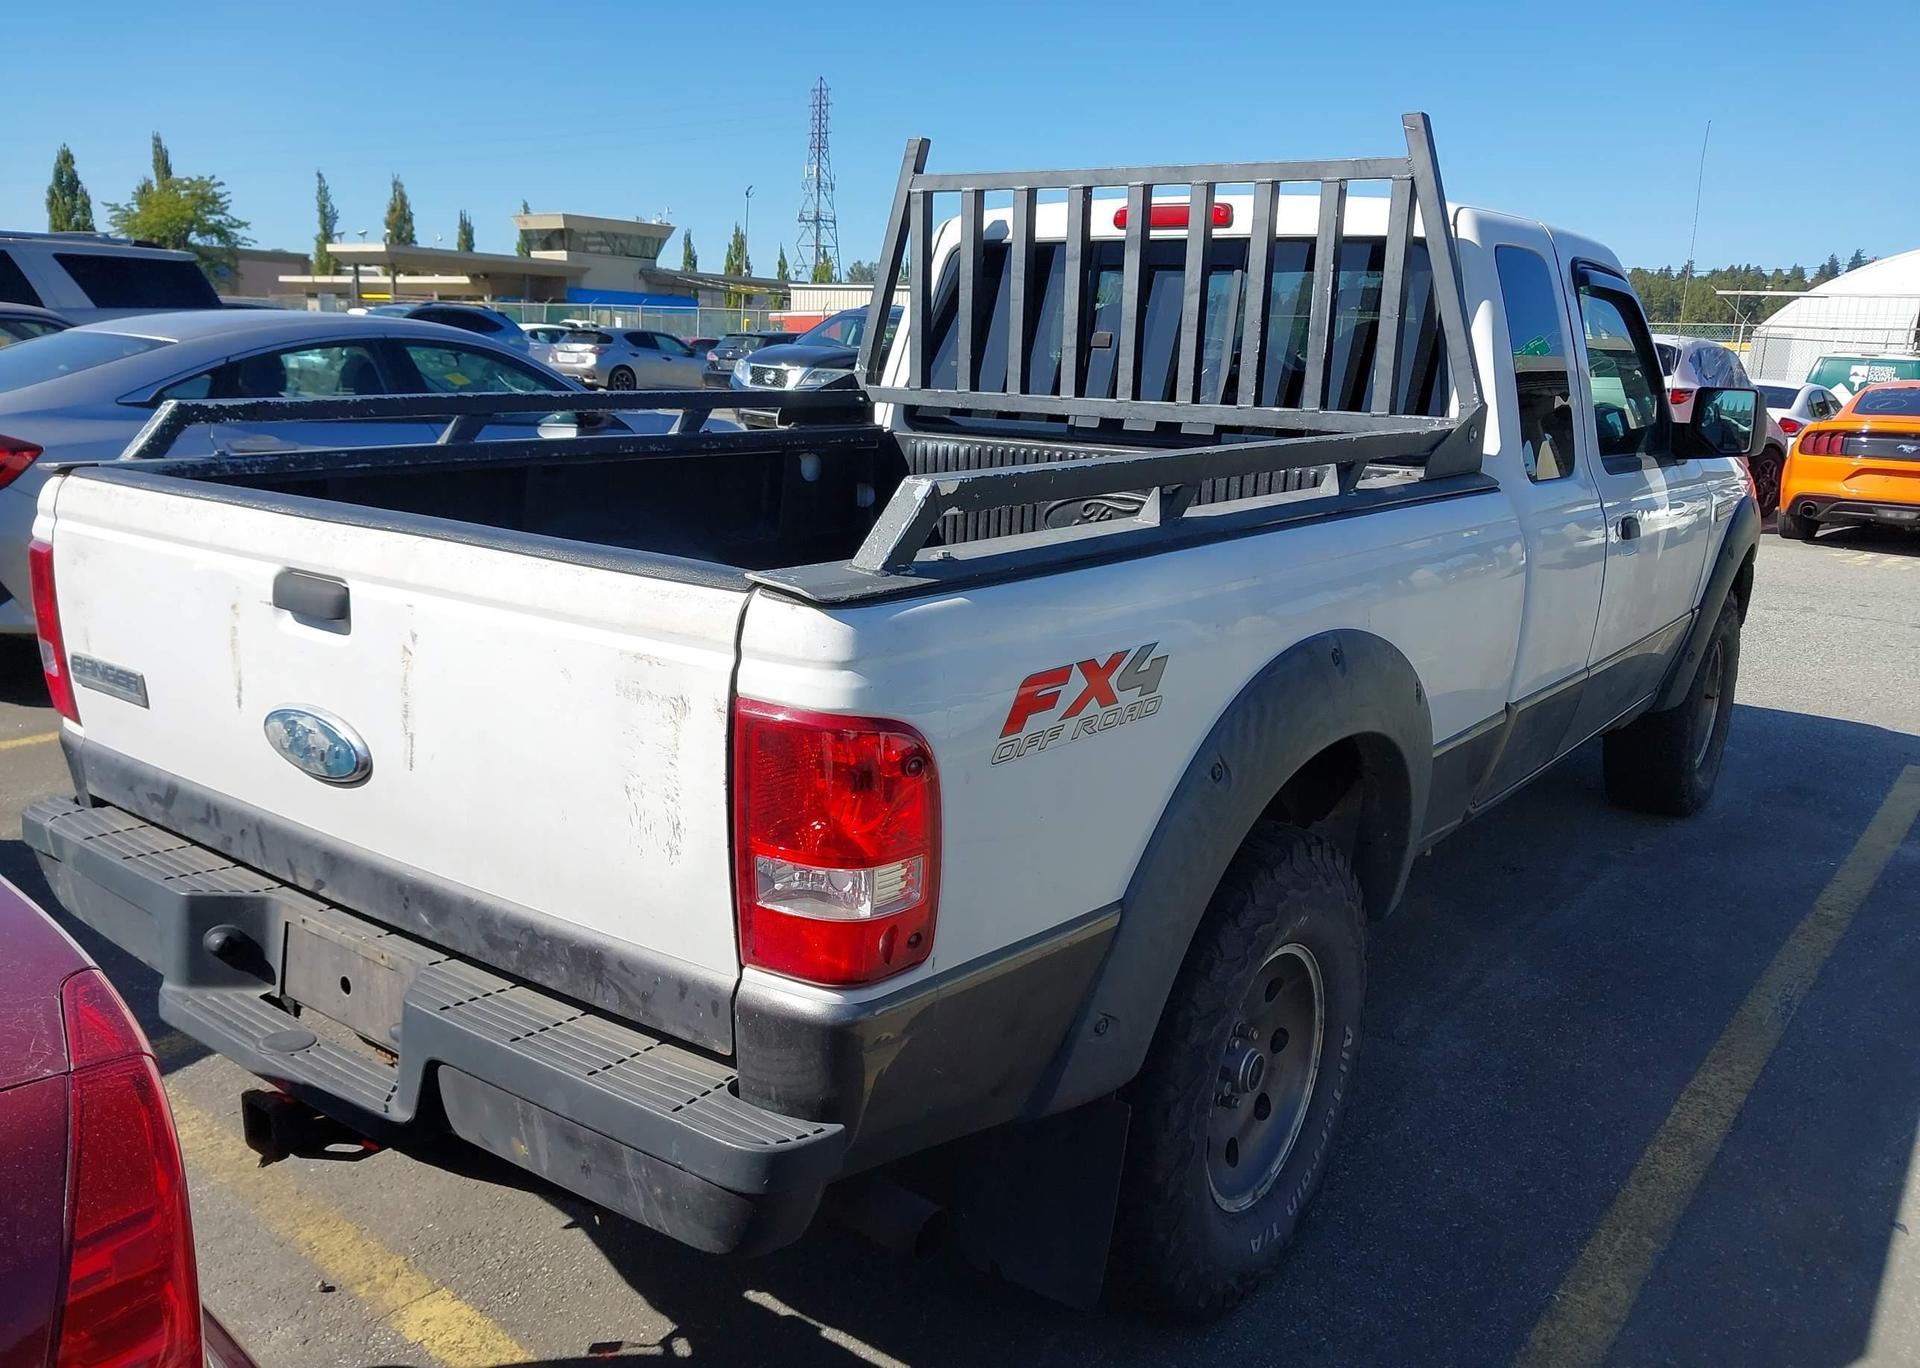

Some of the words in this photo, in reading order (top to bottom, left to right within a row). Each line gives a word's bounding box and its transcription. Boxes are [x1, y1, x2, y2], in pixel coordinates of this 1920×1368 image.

[991, 724, 1065, 766] OFF
[1071, 695, 1163, 741] ROAD
[999, 641, 1169, 740] FX4
